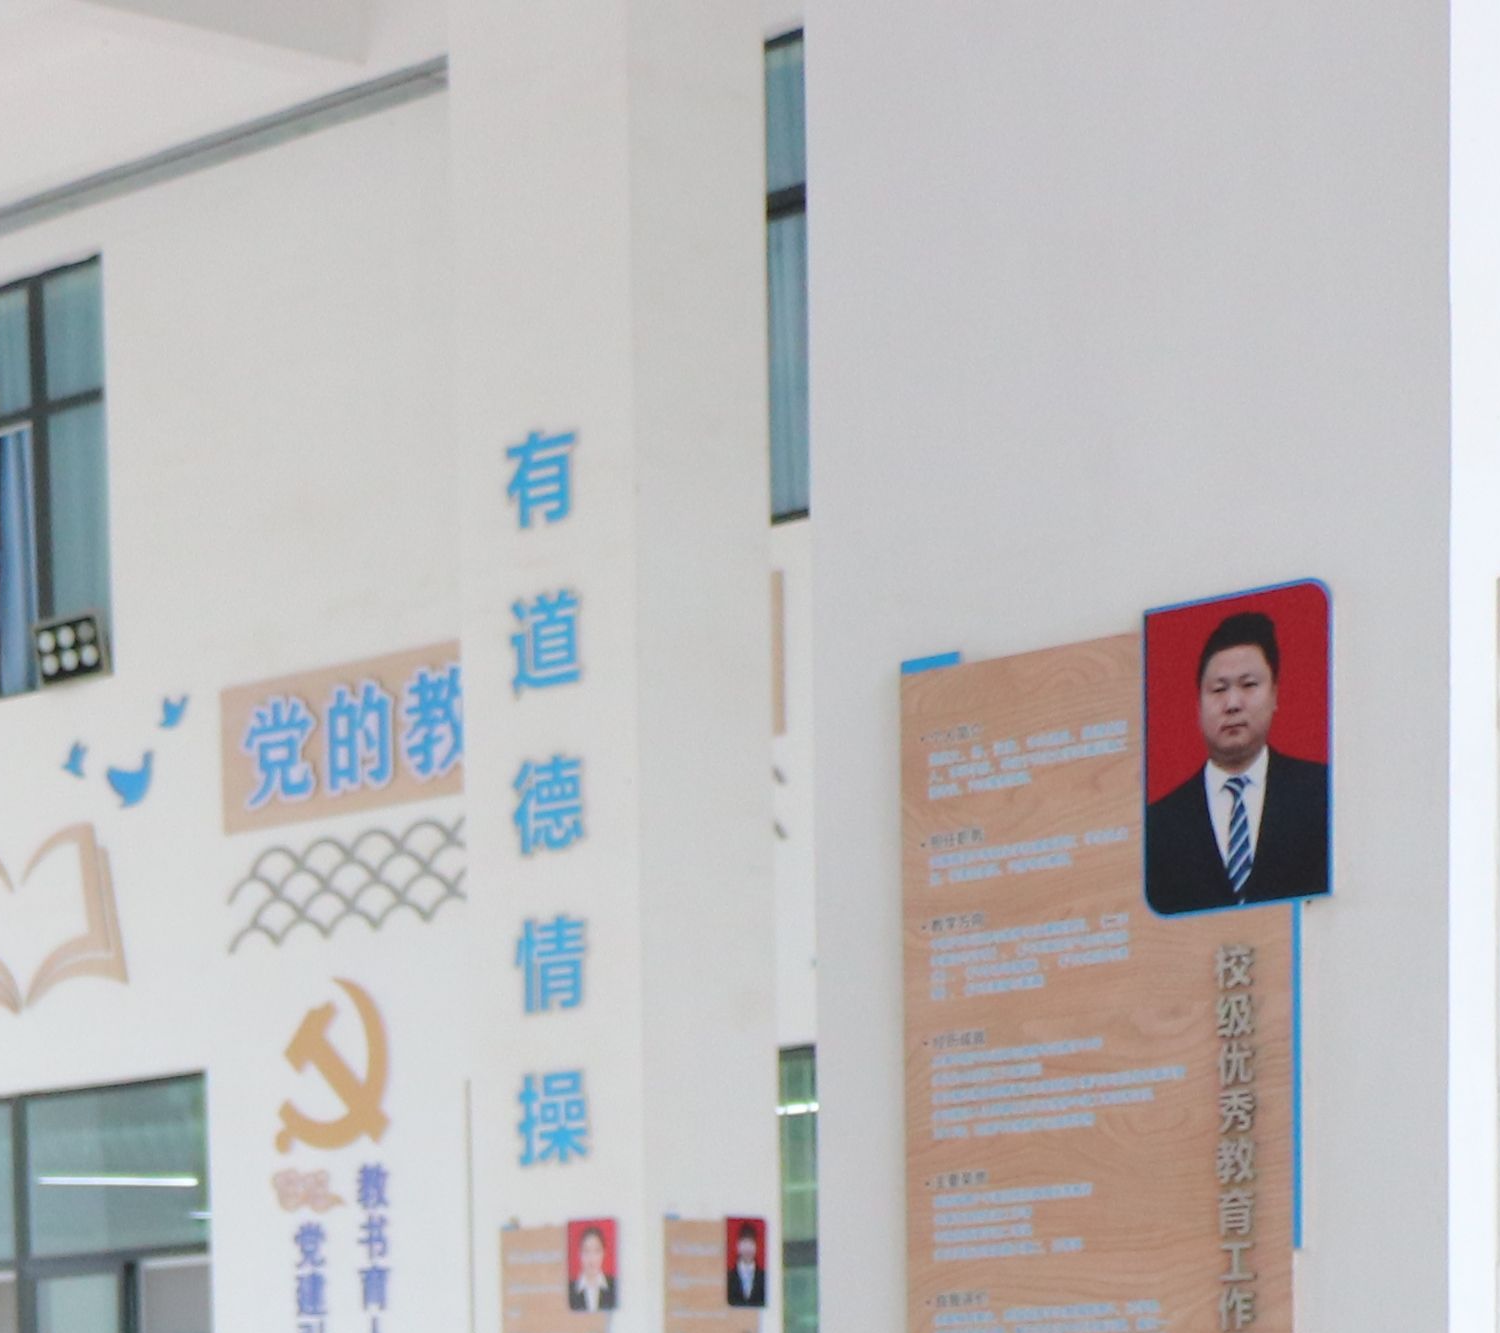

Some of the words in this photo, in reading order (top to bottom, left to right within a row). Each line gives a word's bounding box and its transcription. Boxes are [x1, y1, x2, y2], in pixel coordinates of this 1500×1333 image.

[243, 663, 463, 808] 党的教
[505, 430, 590, 1168] 有道德情操
